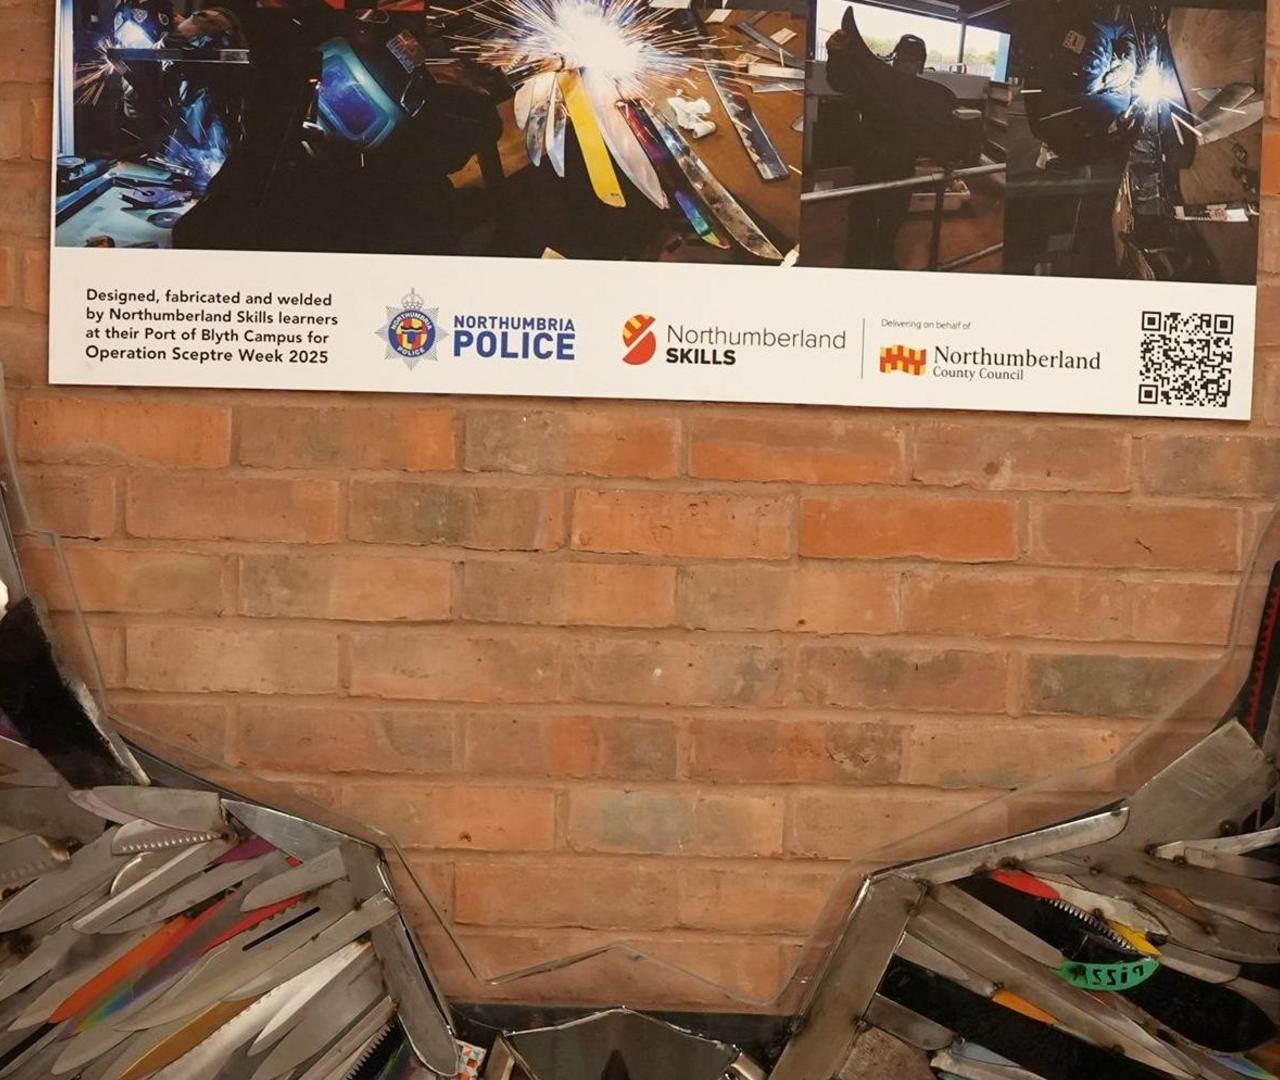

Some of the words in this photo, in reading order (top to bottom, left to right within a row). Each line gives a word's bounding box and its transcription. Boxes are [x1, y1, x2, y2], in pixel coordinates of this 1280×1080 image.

[86, 288, 159, 304] Designed,
[166, 289, 240, 303] fabricated
[245, 292, 272, 304] and
[277, 293, 332, 306] welded
[86, 307, 104, 323] by
[110, 308, 231, 322] Northumberland
[237, 310, 273, 323] Skills
[279, 311, 338, 325] learners
[453, 315, 575, 331] NORTHUMBRIA
[881, 318, 921, 329] Delivering
[936, 321, 961, 329] behalf
[962, 321, 971, 329] of
[86, 328, 100, 338] at
[105, 326, 139, 339] their
[145, 327, 175, 340] Port
[181, 328, 197, 340] of
[201, 328, 239, 344] Blyth
[244, 329, 302, 346] Campus
[308, 331, 329, 343] for
[453, 330, 575, 360] POLICE
[667, 325, 846, 349] Northumberland
[86, 345, 166, 362] Operation
[172, 347, 233, 364] Sceptre
[238, 349, 283, 362] Week
[289, 350, 328, 363] 2025
[666, 348, 736, 365] SKILLS
[934, 346, 1101, 369] Northumberland
[933, 366, 976, 381] County
[979, 368, 1024, 381] Council
